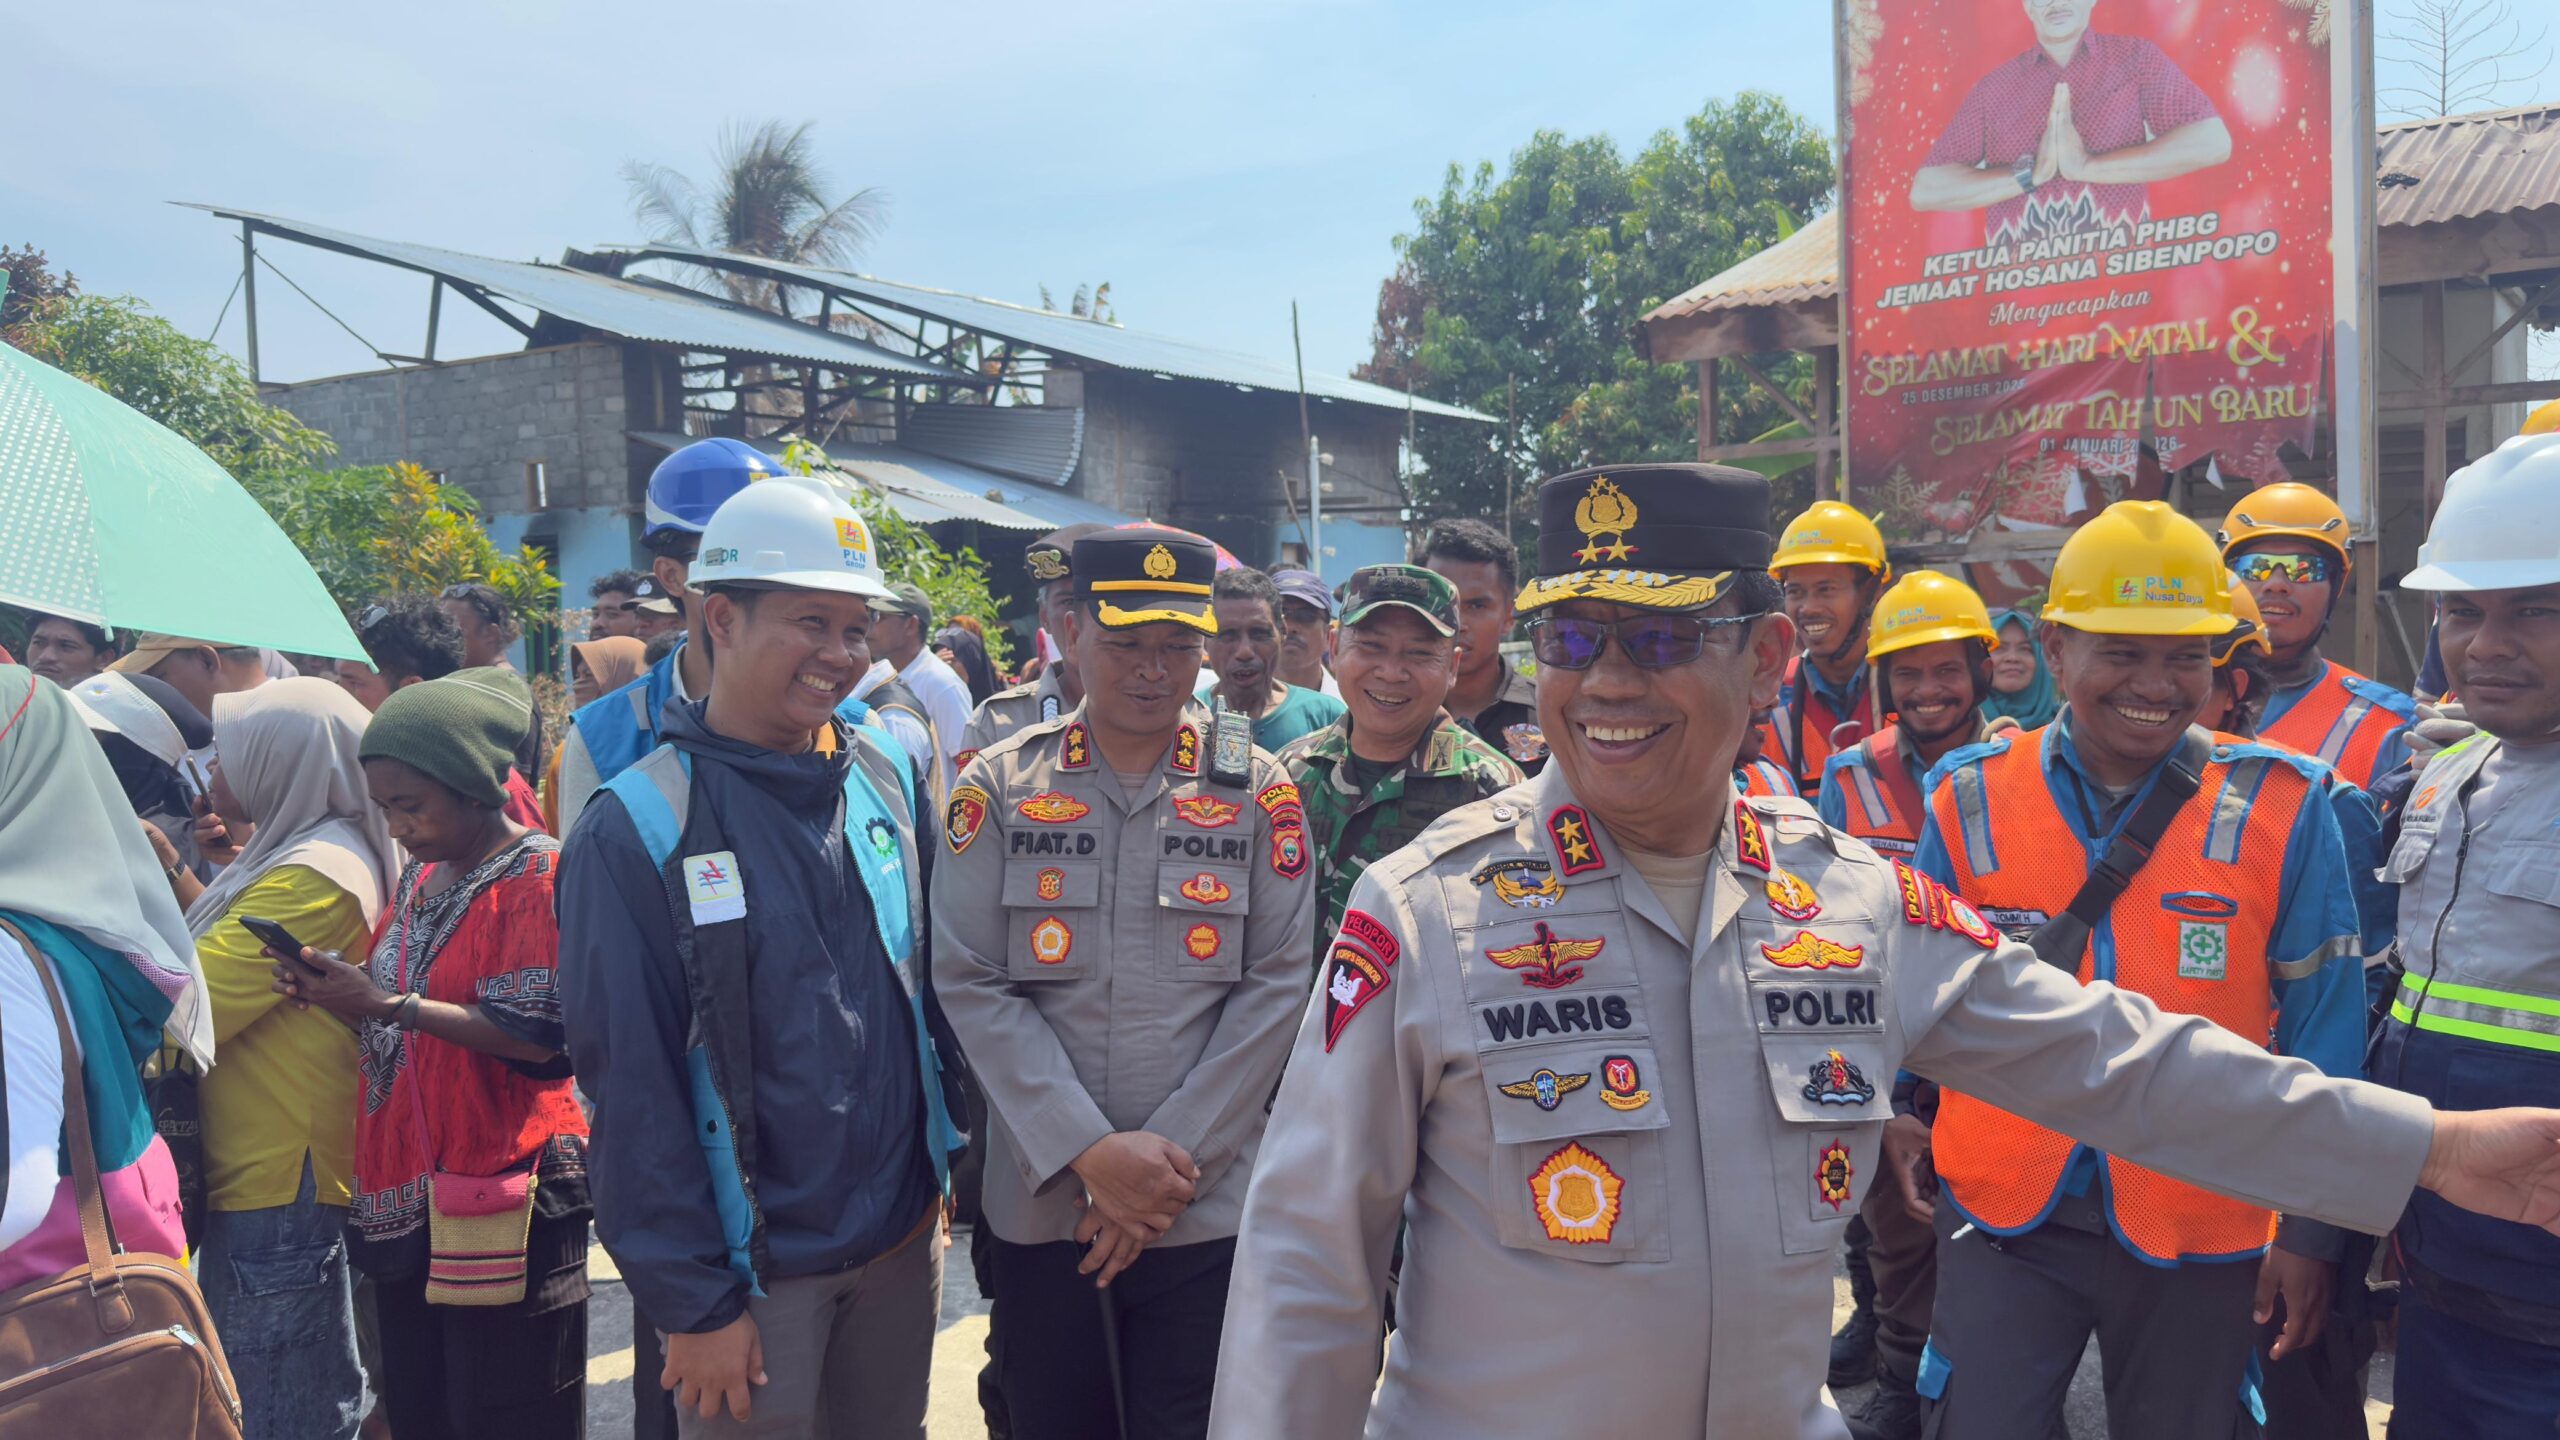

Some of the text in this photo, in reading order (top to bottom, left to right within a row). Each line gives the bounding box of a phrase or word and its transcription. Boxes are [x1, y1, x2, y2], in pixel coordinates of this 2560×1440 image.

[1923, 212, 2219, 277] KETUA PANITIA PHBG
[1876, 231, 2279, 309] JEMAAT HOSANA SIBENPOPO
[1988, 289, 2151, 328] Mengucapkan
[1863, 305, 2285, 396] SELAMAT HARI NATAL &
[1902, 391, 1917, 405] 25
[1922, 385, 1990, 402] DESEMBER
[1931, 401, 2074, 457] SELAMAT
[2209, 383, 2314, 423] BARU
[2040, 437, 2056, 451] 01
[2063, 437, 2124, 451] JANUARI
[843, 549, 866, 562] PLN
[845, 560, 866, 569] GROUP
[2145, 576, 2182, 590] PLN
[2145, 591, 2205, 605] Nusa Daya
[1011, 831, 1096, 855] FIAT.D
[1164, 835, 1247, 860] POLRI
[2181, 966, 2223, 977] SAFETY FIRST
[1482, 995, 1632, 1042] WARIS
[1765, 989, 1877, 1026] POLRI
